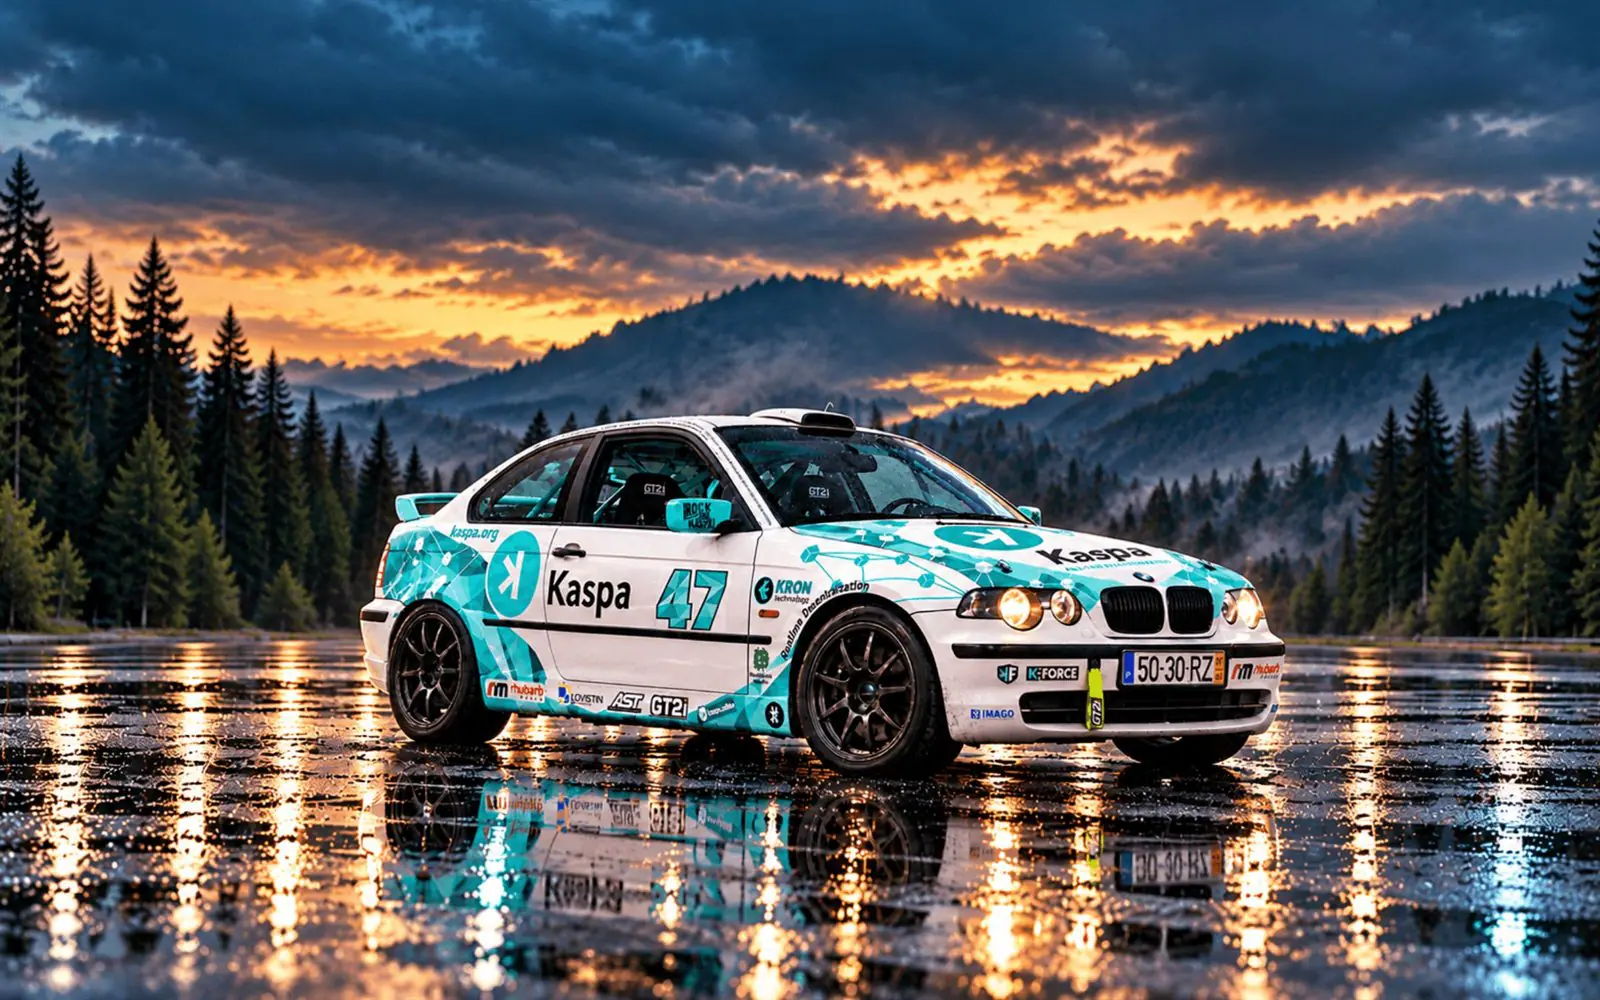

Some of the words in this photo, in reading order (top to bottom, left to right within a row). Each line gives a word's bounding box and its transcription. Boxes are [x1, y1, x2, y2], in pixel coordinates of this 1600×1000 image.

[450, 525, 500, 543] kaspa.org
[1035, 547, 1153, 566] Kaspa
[547, 570, 632, 619] Kaspa
[775, 579, 812, 595] KRON
[655, 568, 729, 631] 47
[1138, 655, 1214, 683] 50-30-RZ
[510, 683, 545, 696] rhubarb
[612, 692, 644, 709] AST
[651, 695, 688, 718] GT2i
[982, 709, 1015, 719] IMAGO
